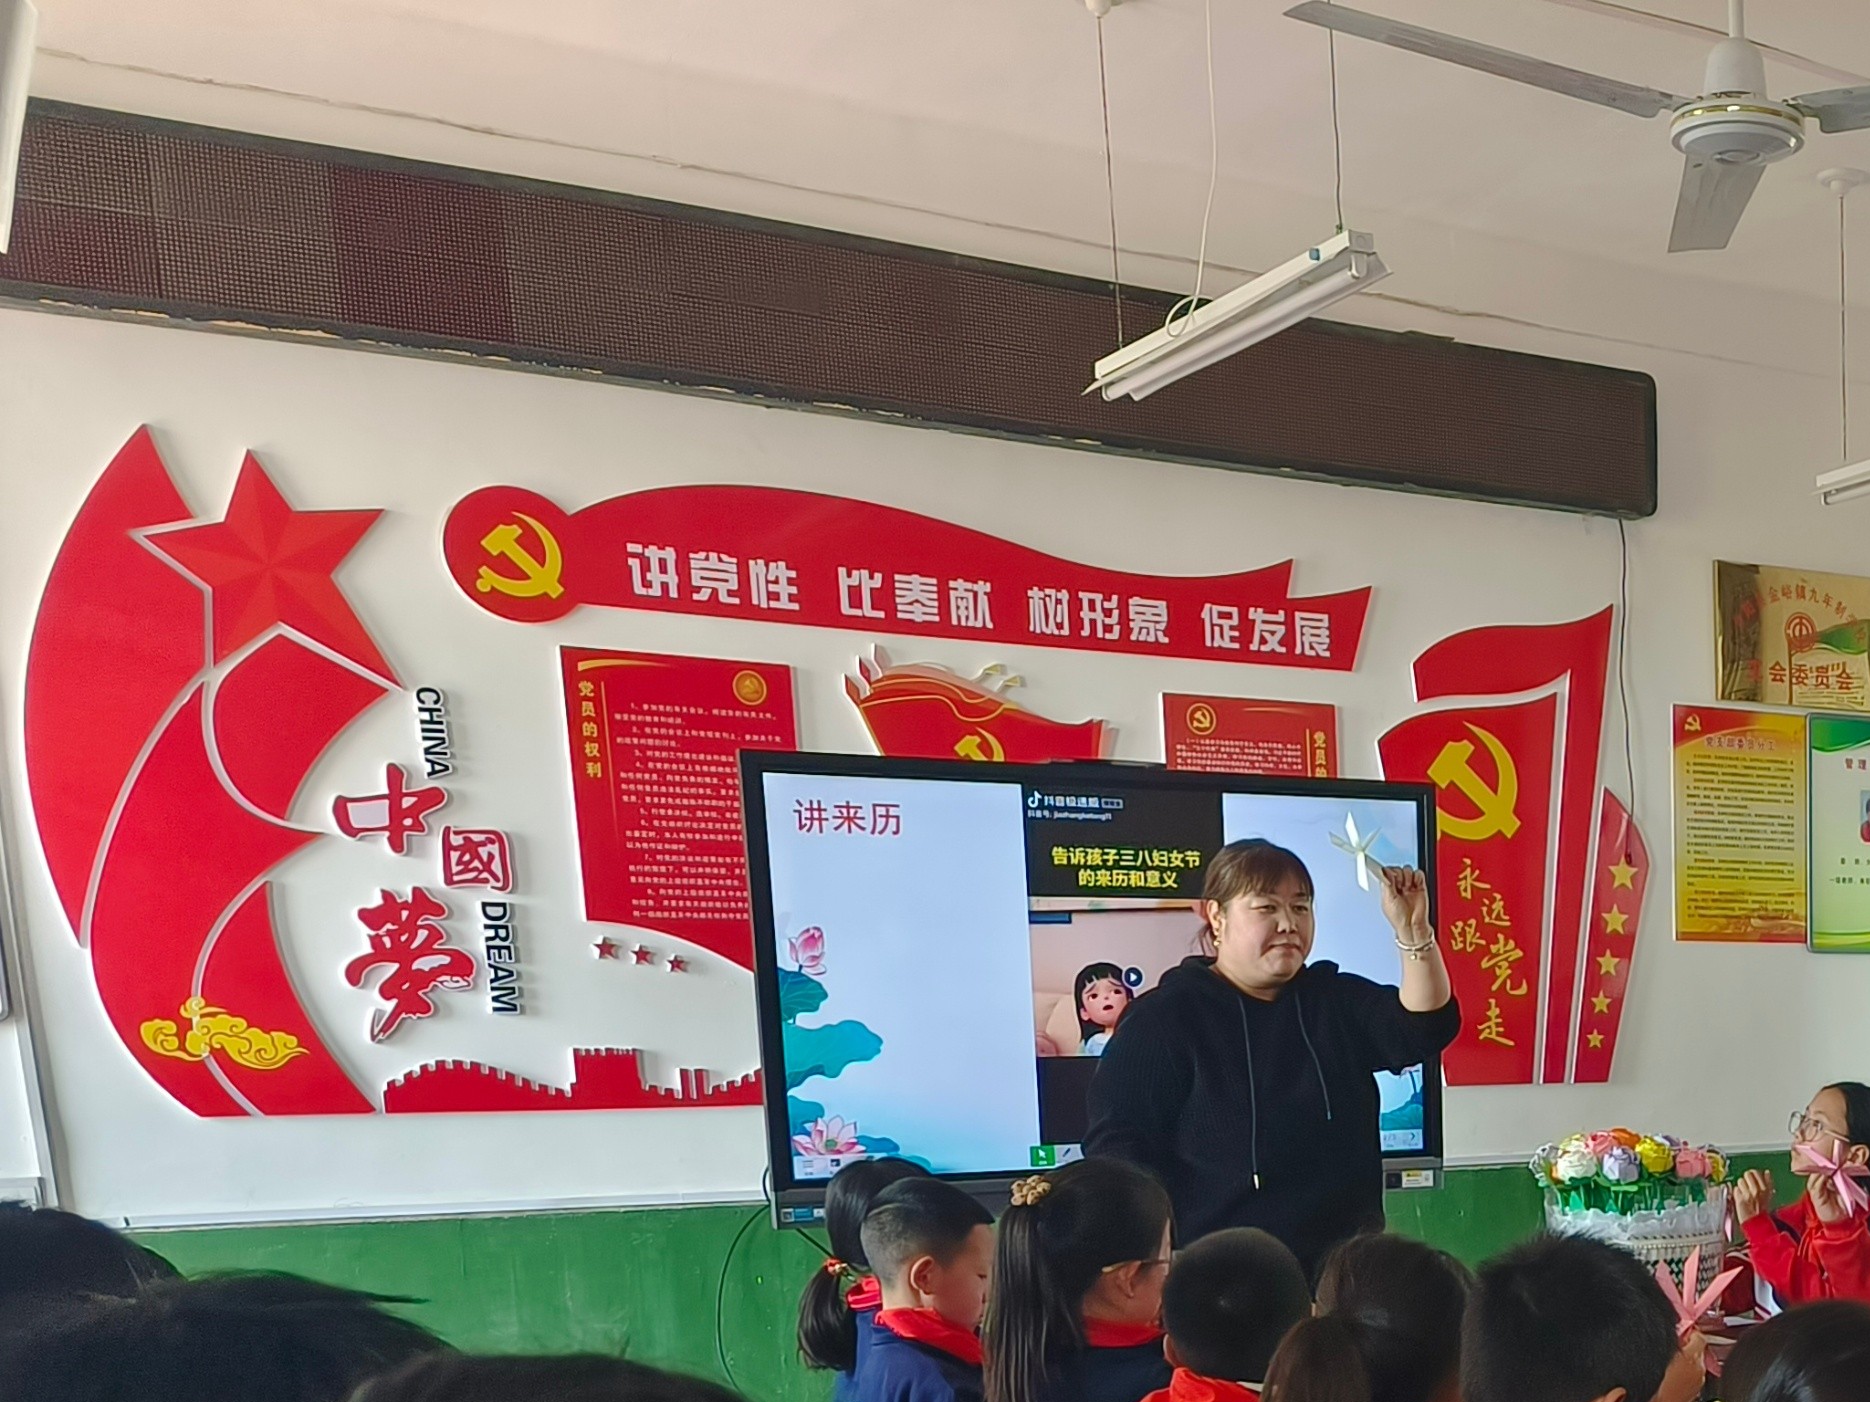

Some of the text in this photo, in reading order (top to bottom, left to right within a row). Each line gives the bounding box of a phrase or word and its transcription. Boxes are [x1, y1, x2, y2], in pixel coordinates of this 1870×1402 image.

[626, 542, 1333, 659] 讲党性 比奉献 树形象 促发展
[1748, 659, 1855, 691] 会委员会
[415, 685, 451, 778] CHINA
[578, 680, 602, 779] 党员的权利
[792, 798, 903, 837] 讲来历
[1051, 846, 1201, 869] 告诉孩子三八妇女节
[1078, 869, 1178, 889] 的来历和意义
[482, 900, 521, 1015] DREAM
[1450, 858, 1528, 1046] 永远跟党走
